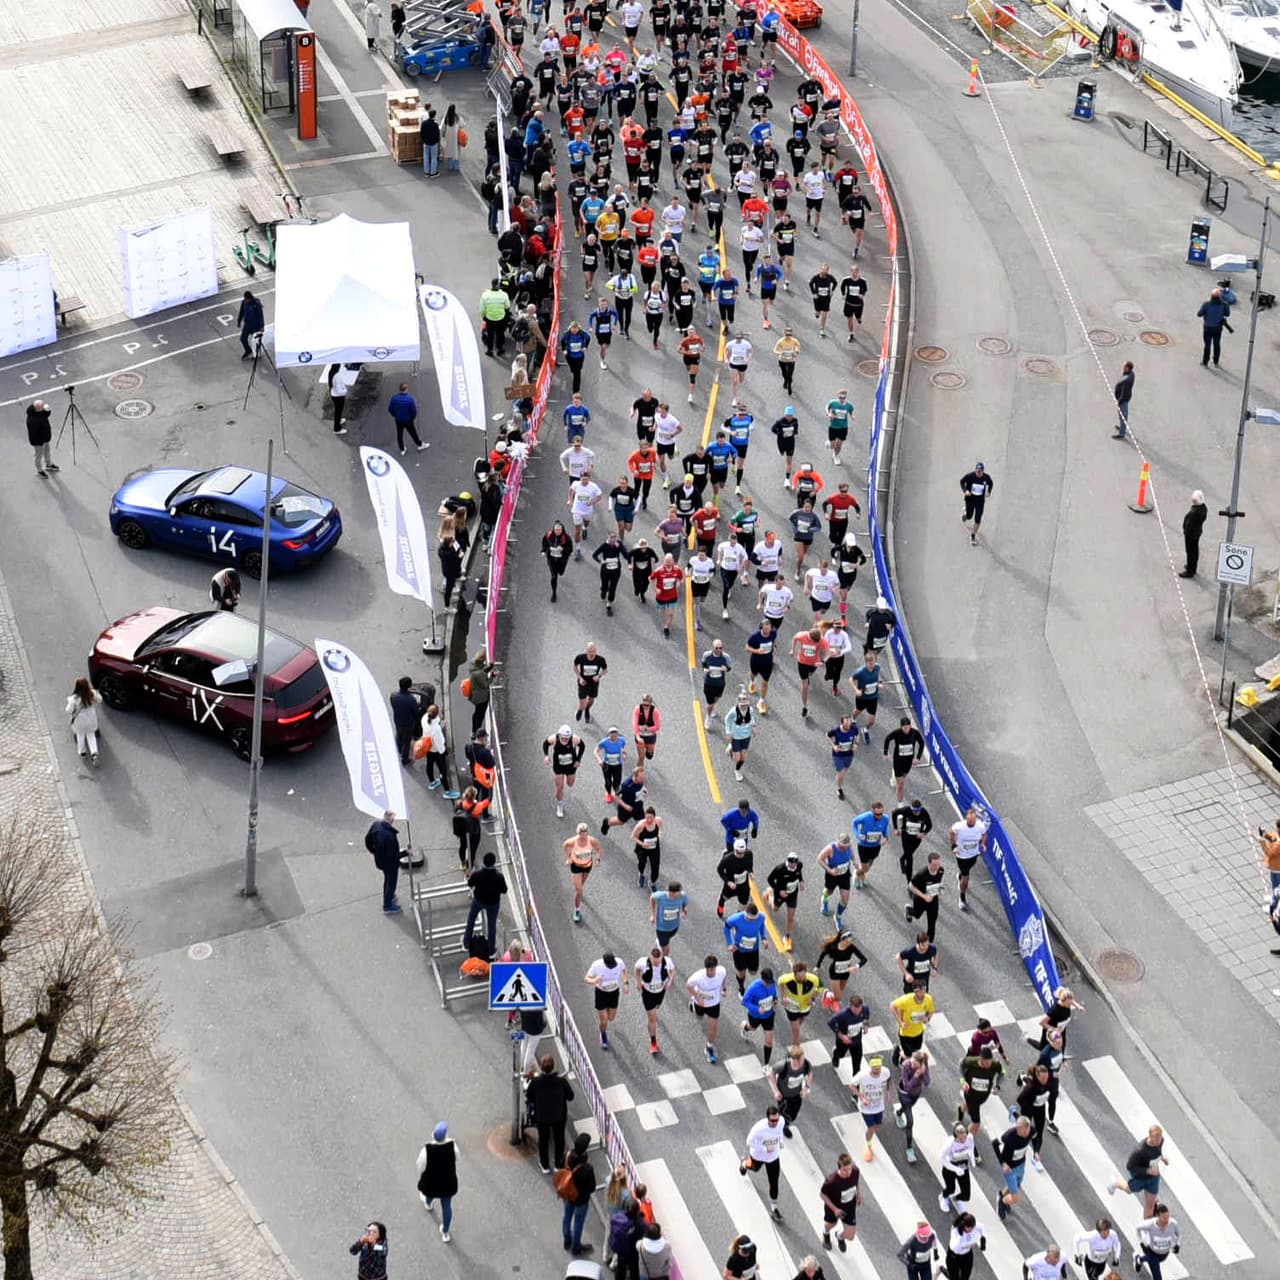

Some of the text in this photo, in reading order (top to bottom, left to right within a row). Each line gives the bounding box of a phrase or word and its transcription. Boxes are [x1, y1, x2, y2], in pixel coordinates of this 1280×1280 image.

[208, 525, 237, 558] i4
[1225, 544, 1248, 556] Sone
[992, 837, 1004, 862] TIF
[1033, 959, 1048, 984] TIF
